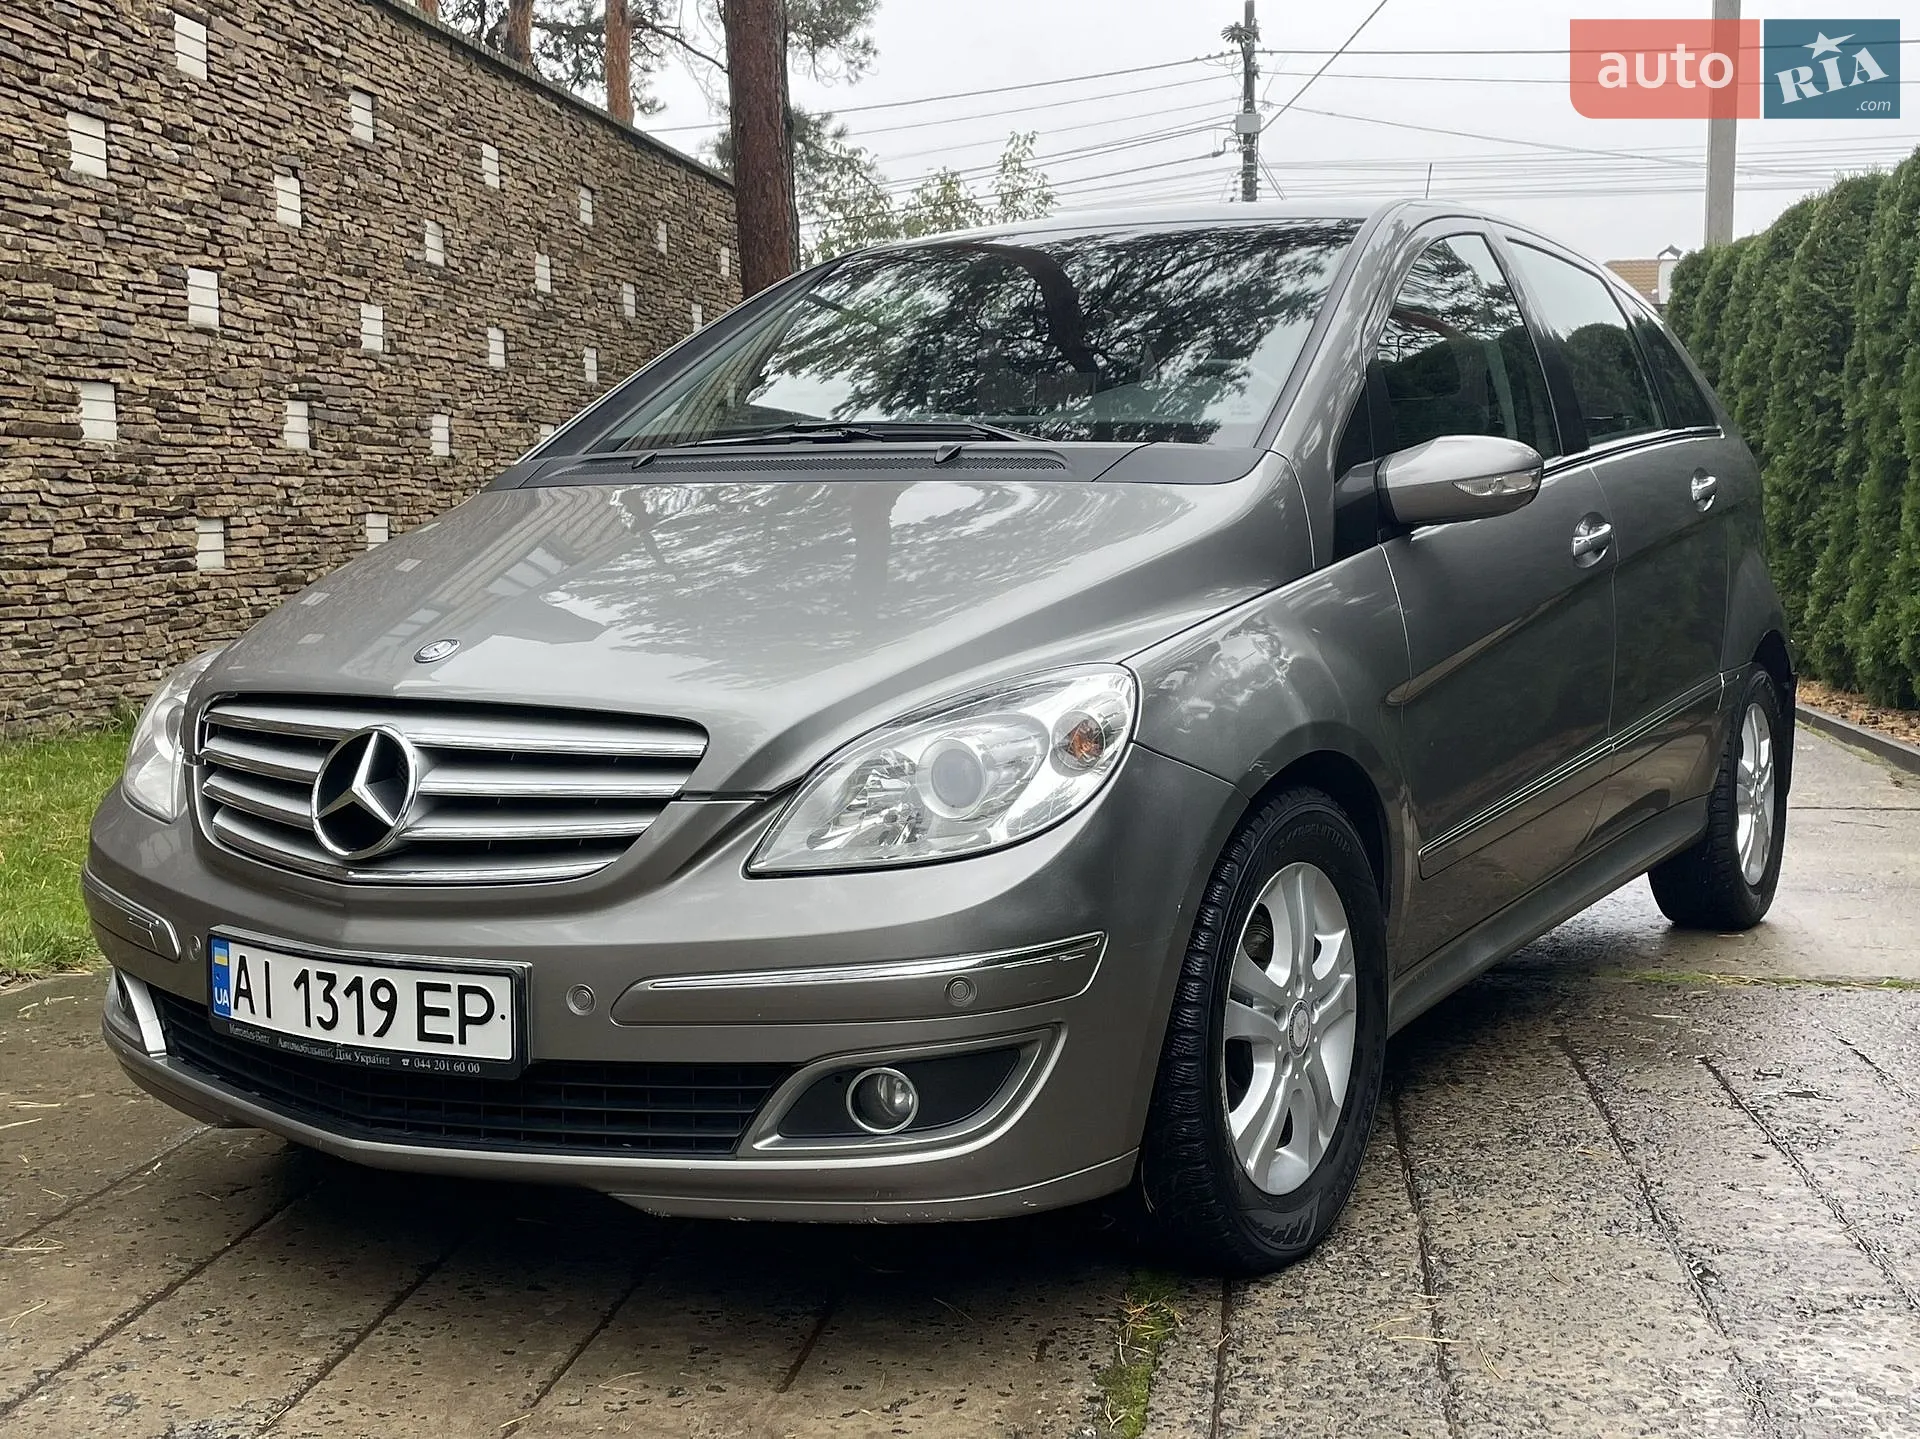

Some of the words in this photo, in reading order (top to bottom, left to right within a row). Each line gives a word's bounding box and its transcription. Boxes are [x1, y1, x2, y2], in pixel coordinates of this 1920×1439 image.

[214, 987, 230, 1007] UA
[233, 954, 272, 1019] AI
[293, 968, 398, 1038] 1319
[416, 981, 495, 1046] EP
[354, 1051, 390, 1066] Україна
[413, 1058, 431, 1069] 044
[434, 1059, 450, 1071] 201
[453, 1061, 466, 1072] 60
[468, 1062, 480, 1074] 00
